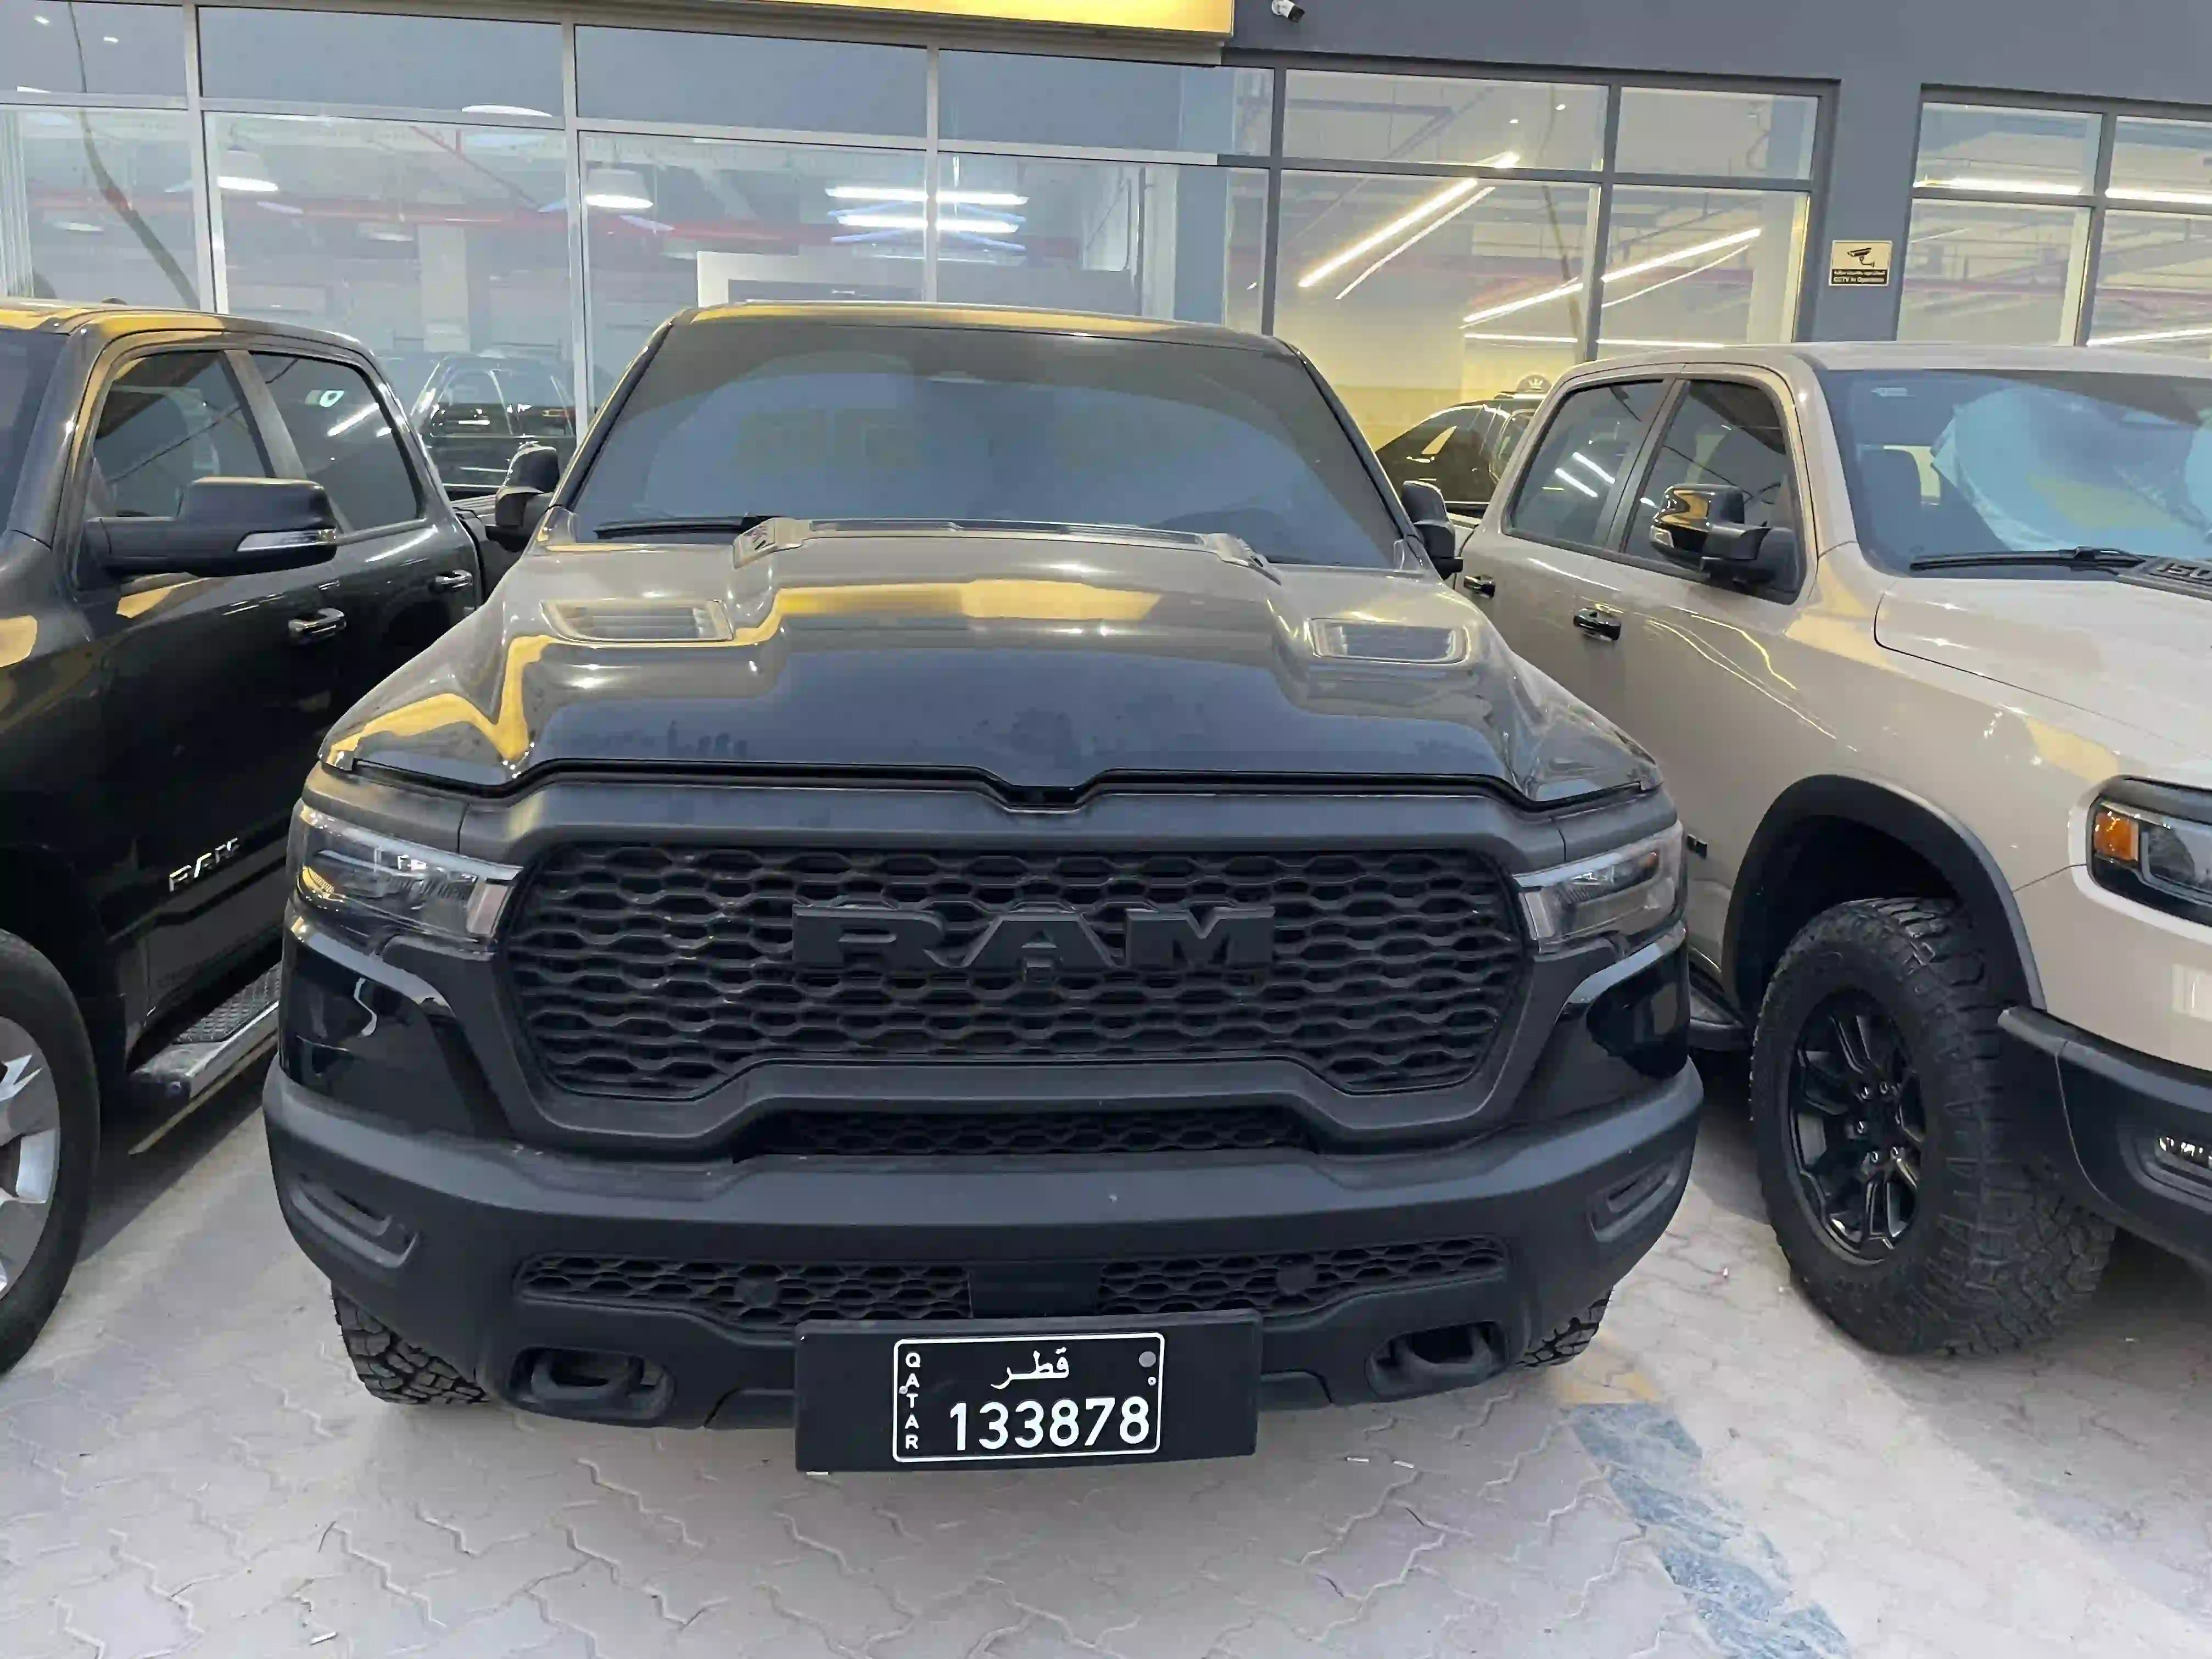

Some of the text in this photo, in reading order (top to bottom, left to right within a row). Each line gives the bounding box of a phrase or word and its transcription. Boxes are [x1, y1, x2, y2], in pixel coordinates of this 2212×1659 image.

[792, 904, 1275, 969] RAM
[991, 1347, 1070, 1389] قطر
[905, 1353, 920, 1449] QATAR
[949, 1396, 1149, 1451] 133878
